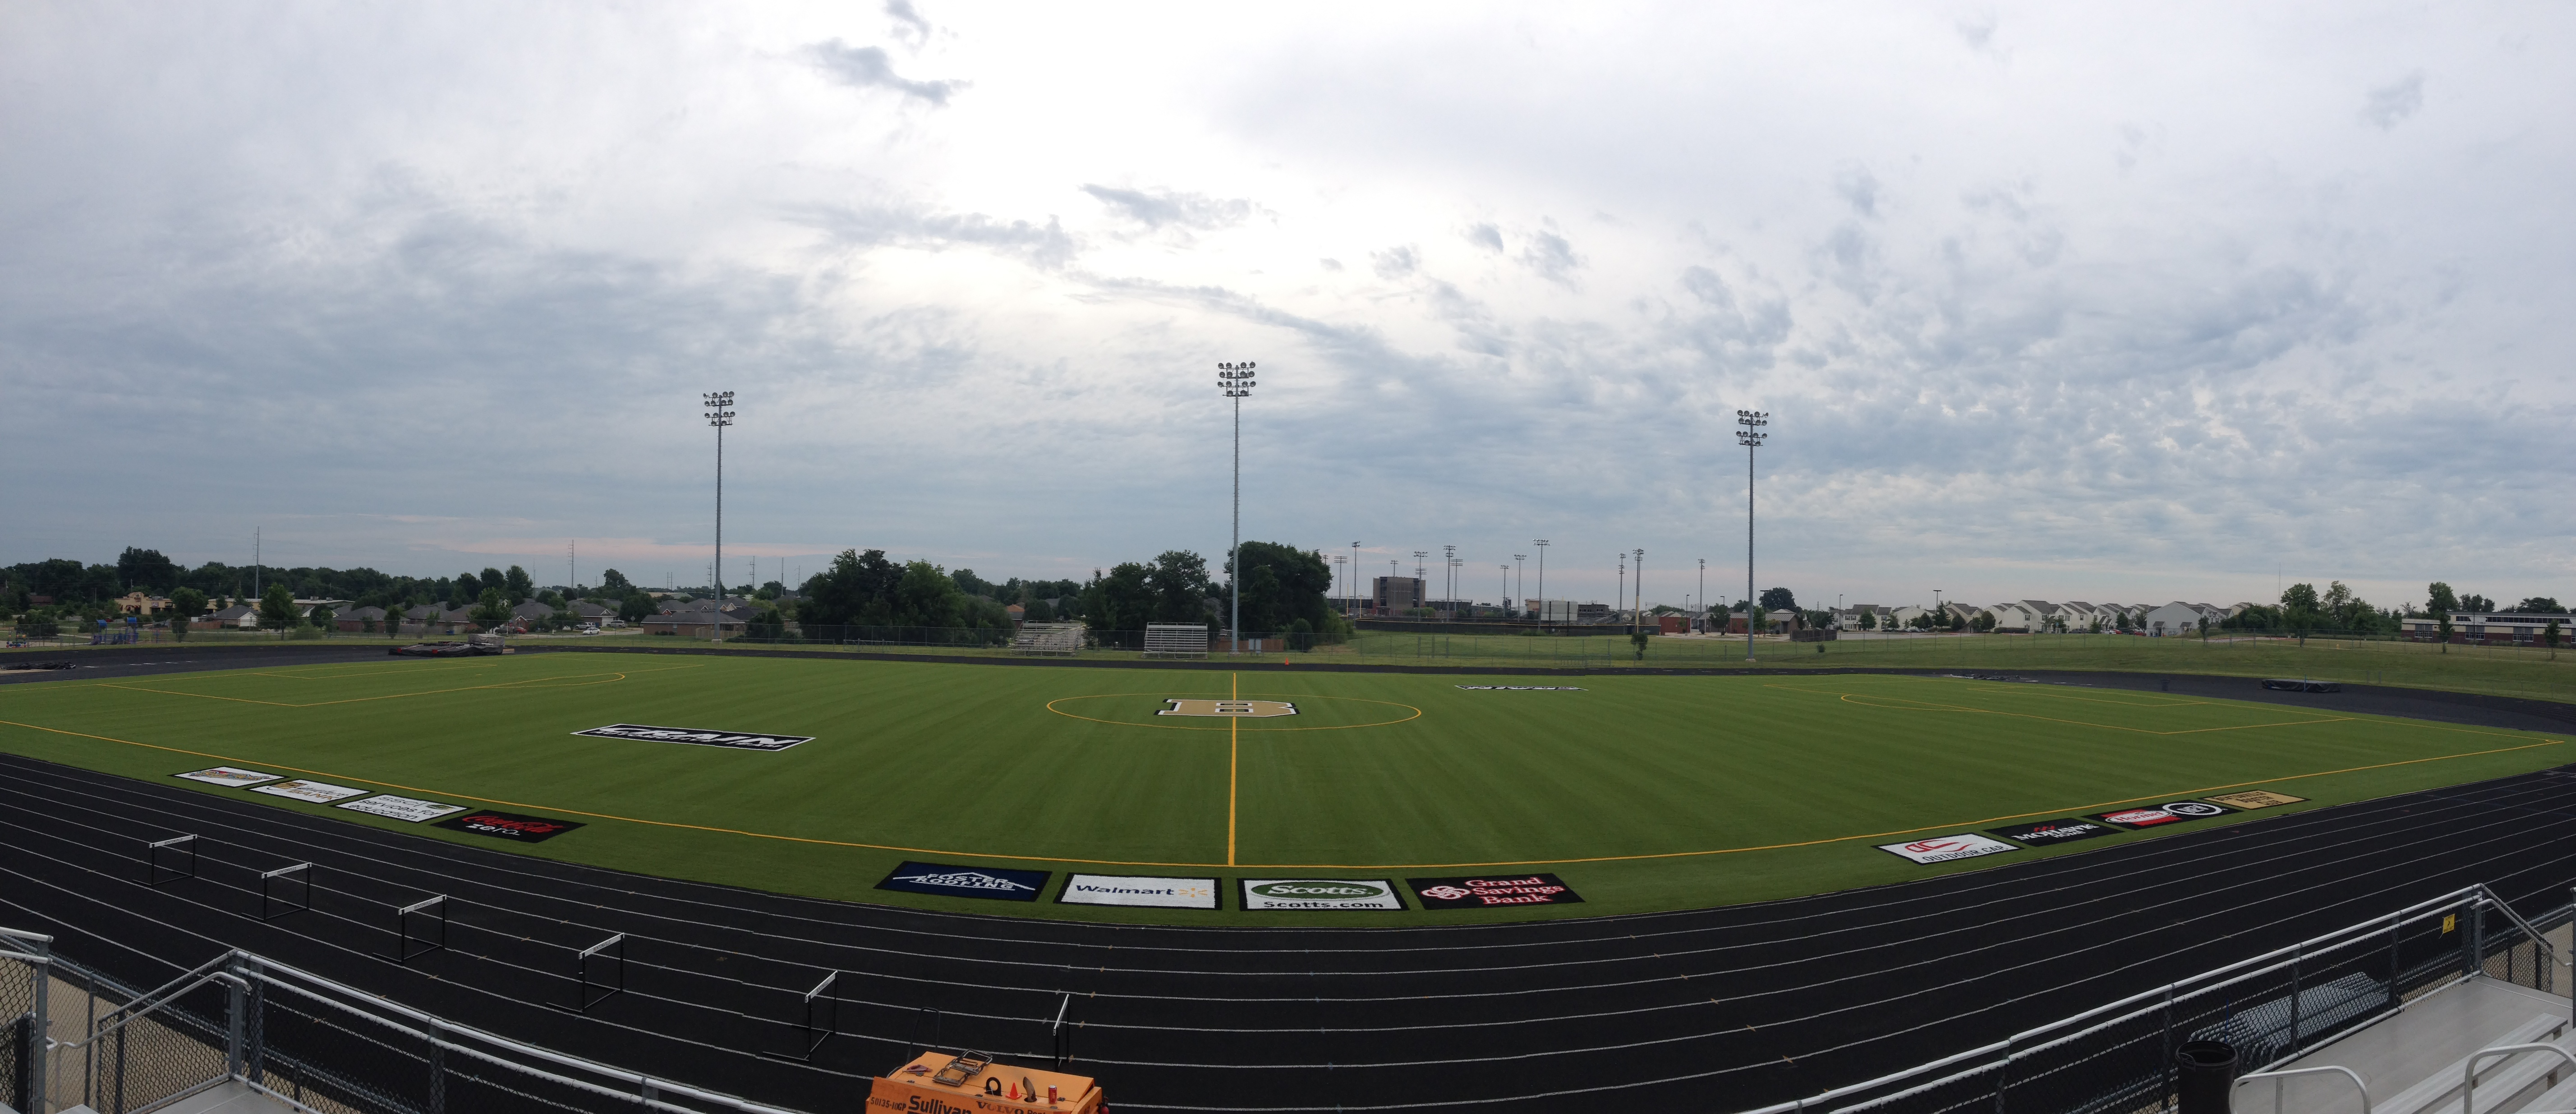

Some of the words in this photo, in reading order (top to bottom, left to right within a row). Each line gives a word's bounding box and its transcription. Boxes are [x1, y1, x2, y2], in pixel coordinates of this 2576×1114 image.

[589, 731, 718, 743] AUTOMOTIVE
[599, 727, 801, 745] CRAIN
[286, 789, 339, 800] BANK
[359, 799, 418, 812] services
[348, 804, 419, 820] education
[2115, 812, 2163, 822] Hormel
[2011, 824, 2099, 840] MOHAWK
[2051, 830, 2086, 838] HOME
[1922, 849, 1982, 861] OUTDOOR
[277, 866, 297, 875] BENTONVILLE
[915, 878, 1014, 888] ROOFING
[926, 874, 1008, 884] FOSTER
[1464, 877, 1546, 887] Grand
[1076, 885, 1174, 895] Walmart
[1472, 885, 1566, 895] Savings
[1478, 893, 1553, 905] Bank
[414, 900, 432, 910] BENTONVILLE
[593, 940, 611, 952] BENTONVILLE
